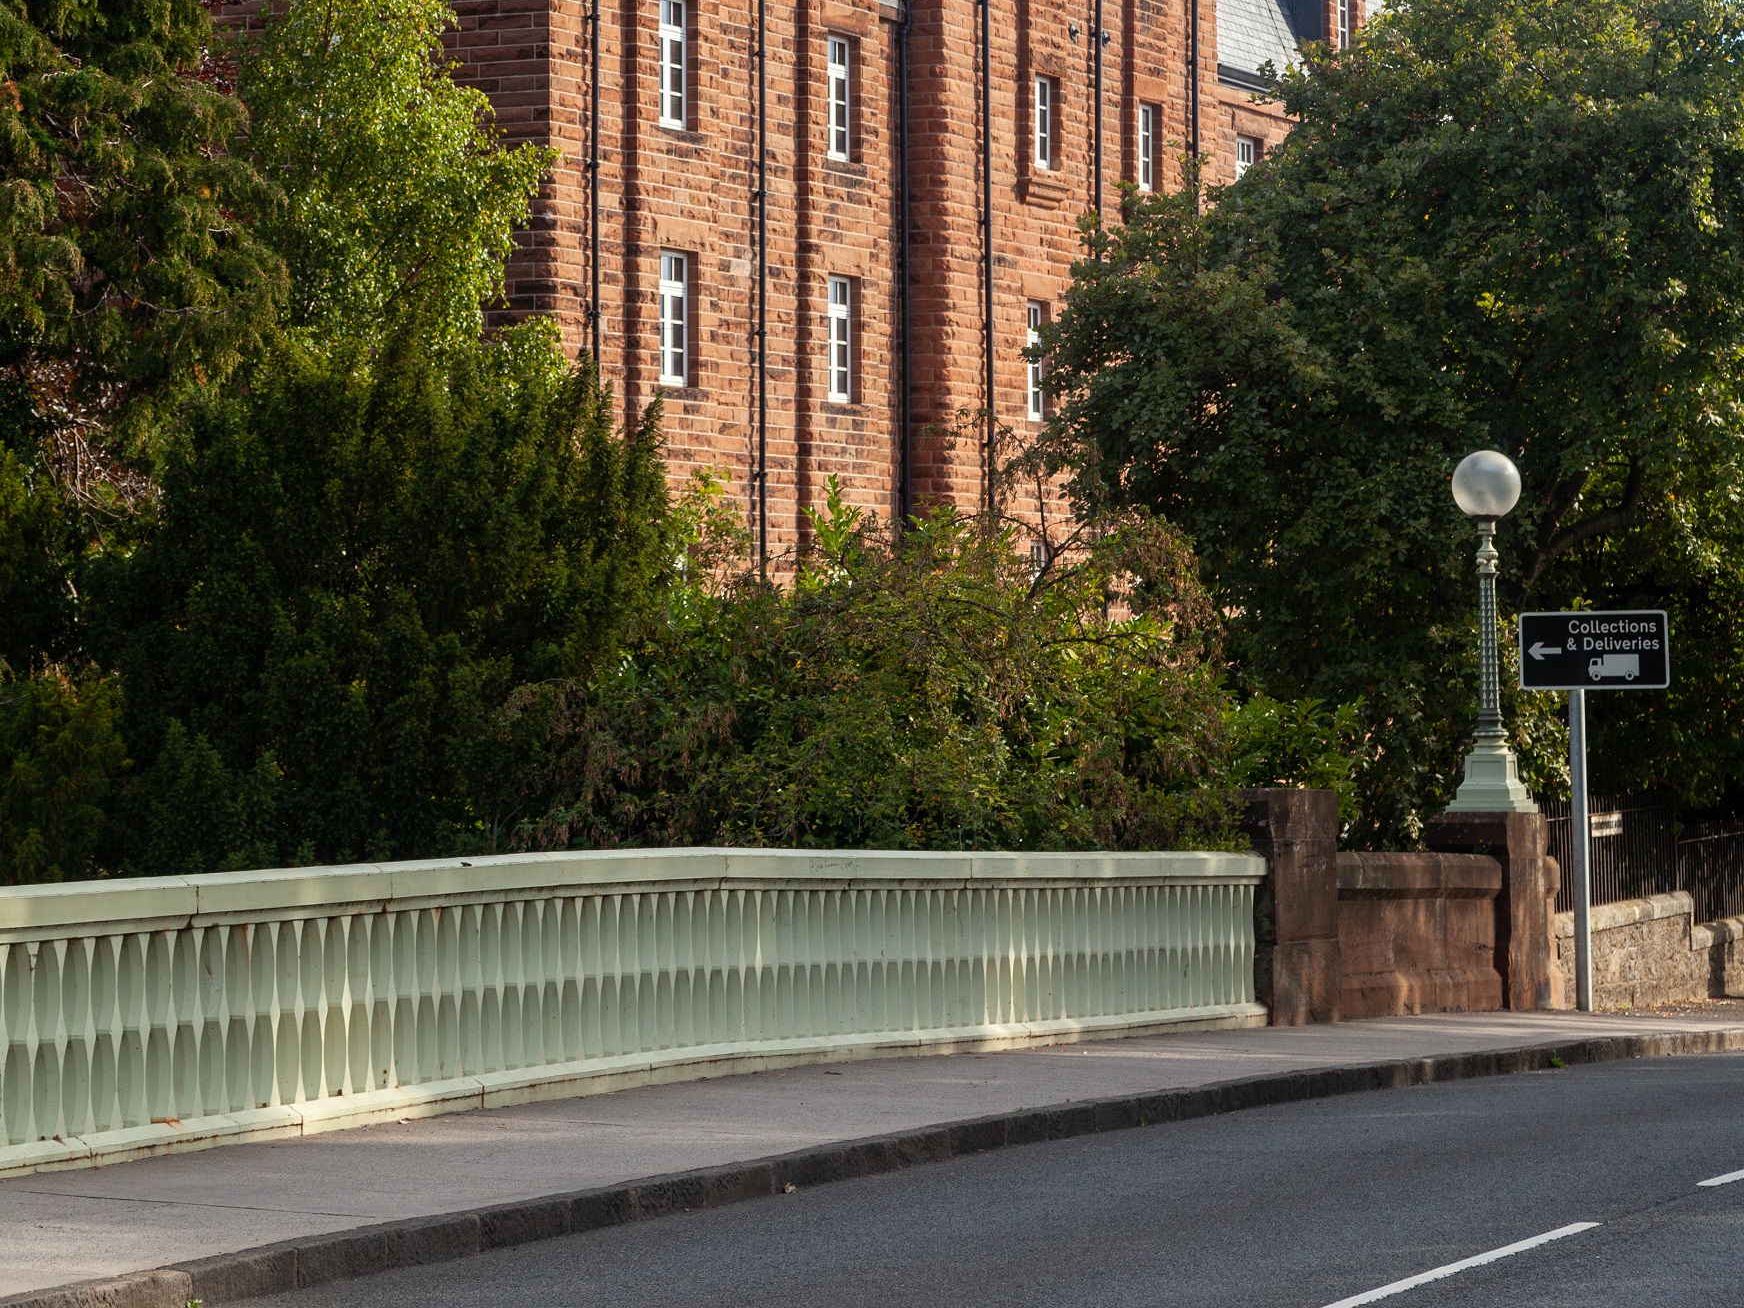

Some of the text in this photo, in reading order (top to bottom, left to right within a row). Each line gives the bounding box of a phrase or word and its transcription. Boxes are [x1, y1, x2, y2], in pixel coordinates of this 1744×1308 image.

[1568, 619, 1657, 634] Collections
[1566, 636, 1660, 651] & Deliveries
